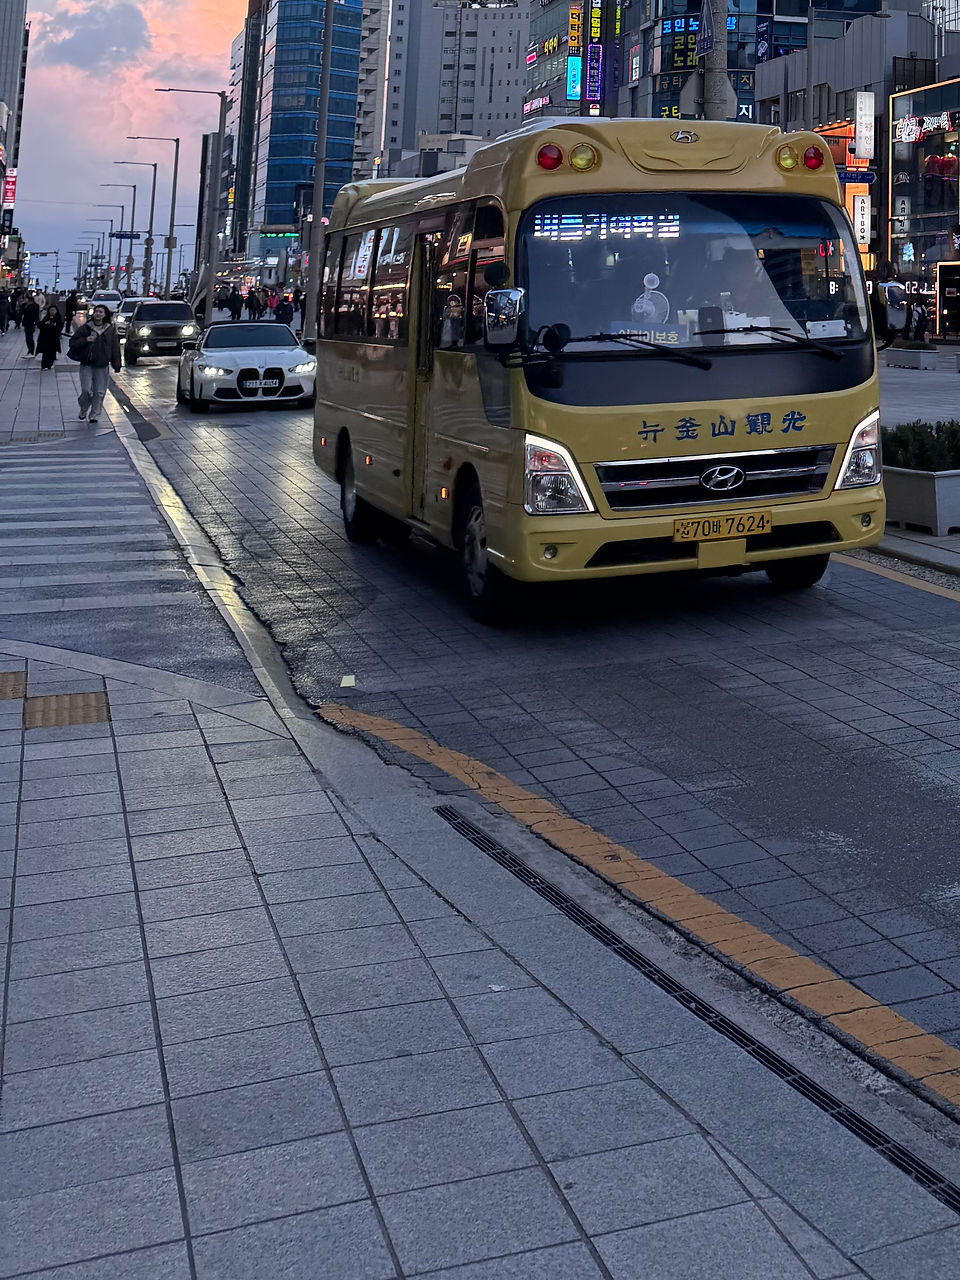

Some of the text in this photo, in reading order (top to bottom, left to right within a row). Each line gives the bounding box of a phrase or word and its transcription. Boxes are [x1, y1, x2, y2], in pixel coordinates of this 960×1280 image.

[569, 12, 581, 45] 더타이
[690, 520, 722, 537] 70바
[726, 515, 766, 535] 7624
